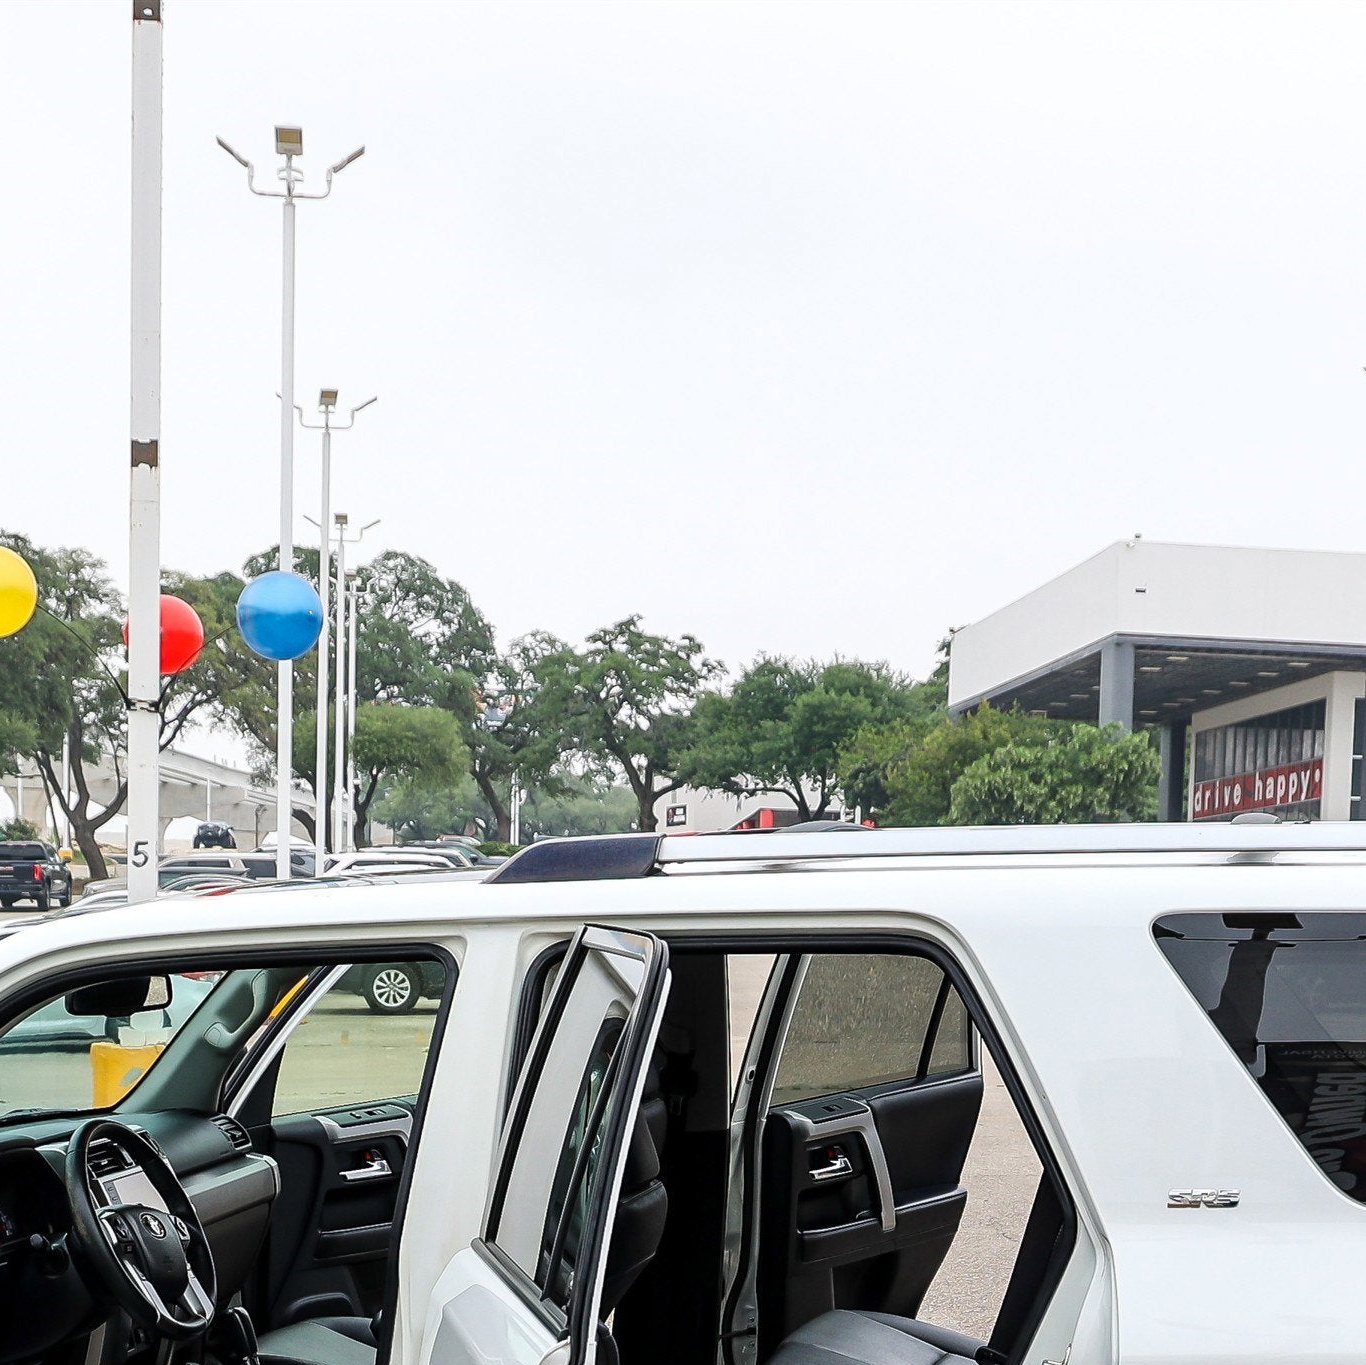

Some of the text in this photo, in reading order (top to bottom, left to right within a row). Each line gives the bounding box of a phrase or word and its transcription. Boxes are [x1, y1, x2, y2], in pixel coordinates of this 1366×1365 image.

[1194, 768, 1311, 812] drive happy
[131, 840, 149, 868] 5
[1167, 1187, 1241, 1208] SR5
